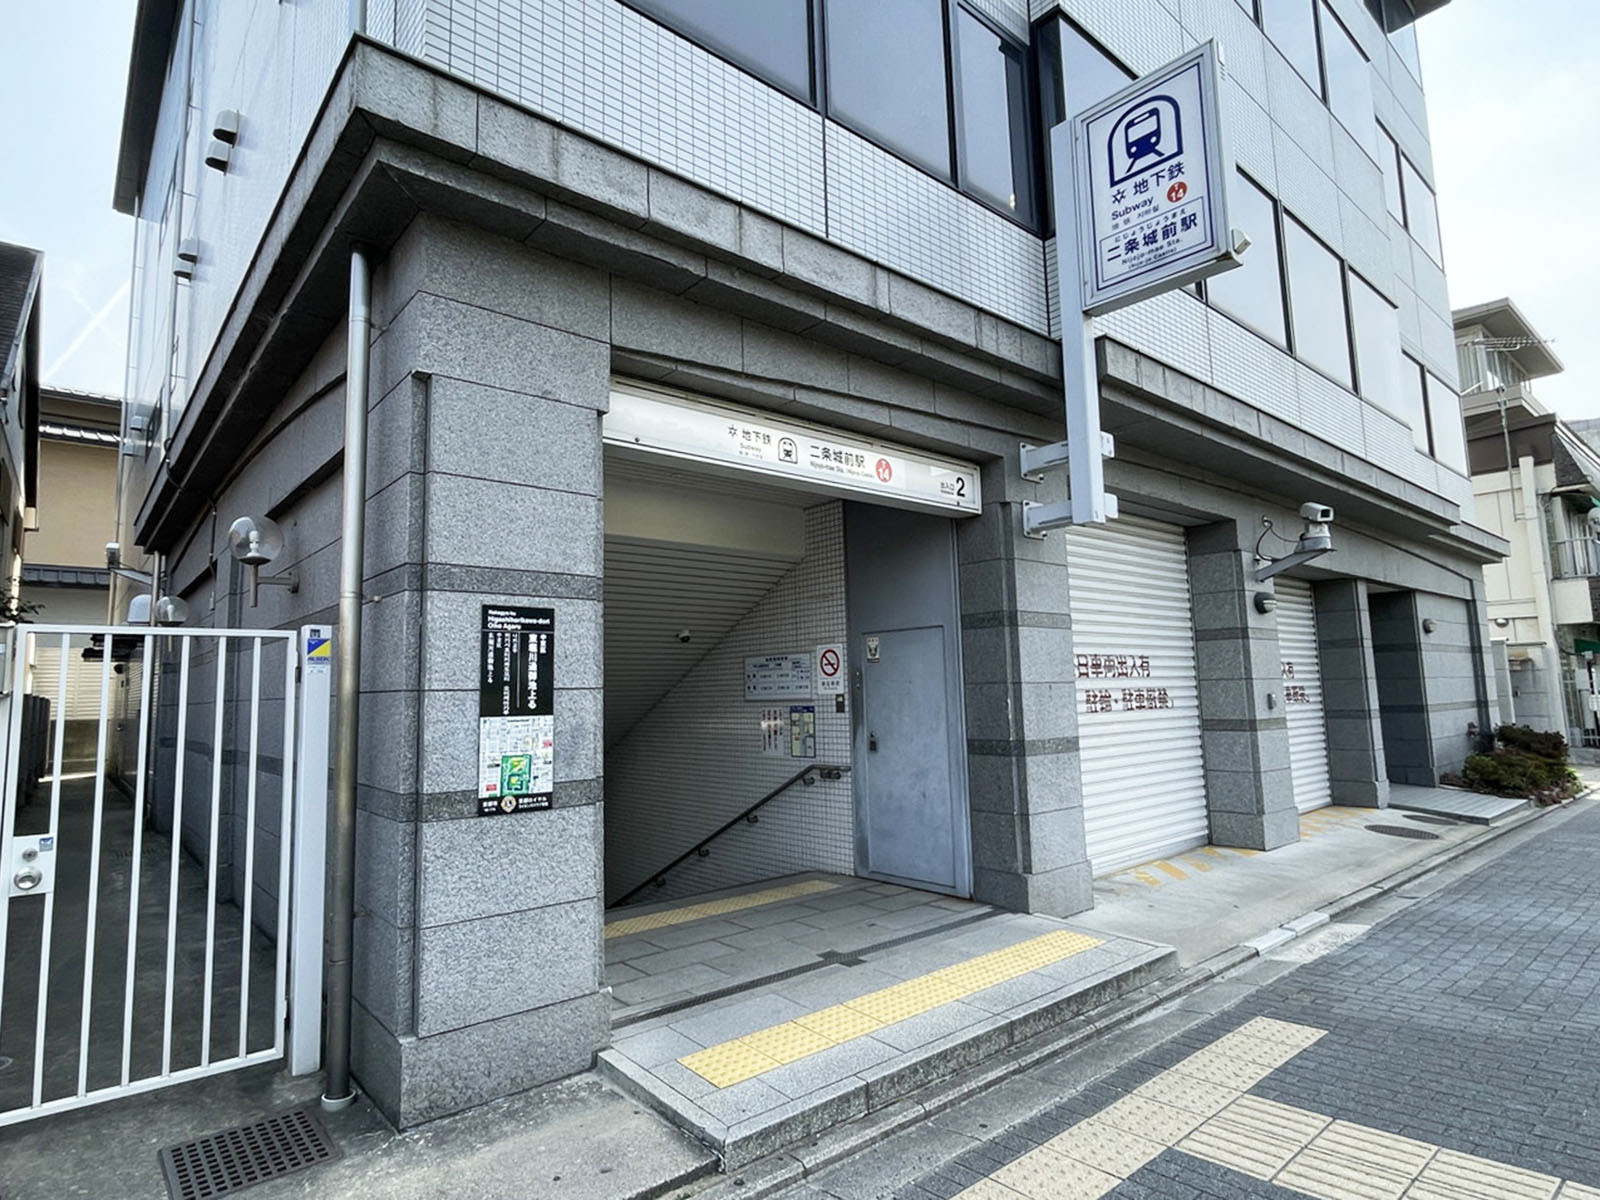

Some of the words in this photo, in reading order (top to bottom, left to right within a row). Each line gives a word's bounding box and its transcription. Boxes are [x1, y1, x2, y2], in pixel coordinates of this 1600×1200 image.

[1133, 161, 1185, 196] 地下鉄
[1171, 188, 1186, 201] 14
[1111, 196, 1154, 221] Subway
[1107, 213, 1197, 262] 二条城前駅
[742, 429, 772, 445] 地下鉄
[810, 445, 866, 468] 二条城前駅
[956, 476, 966, 498] 2
[1074, 654, 1150, 678] 日車両出入有
